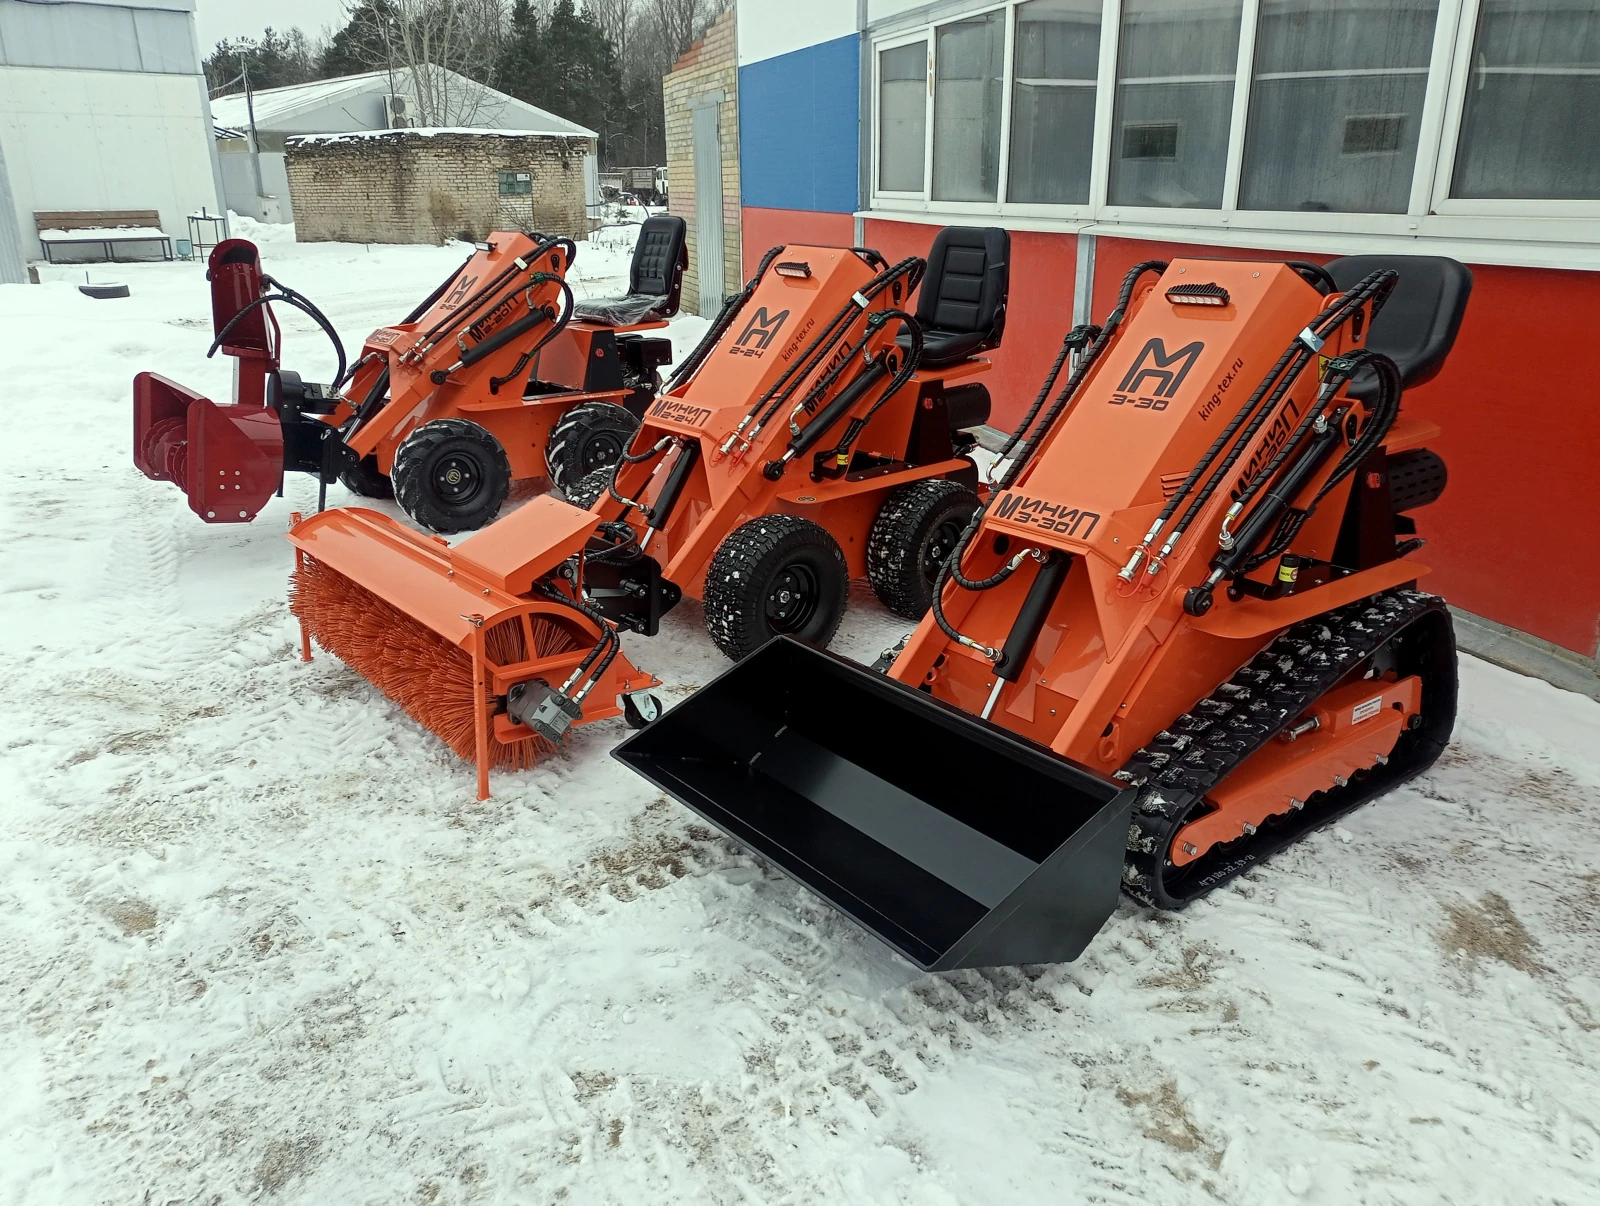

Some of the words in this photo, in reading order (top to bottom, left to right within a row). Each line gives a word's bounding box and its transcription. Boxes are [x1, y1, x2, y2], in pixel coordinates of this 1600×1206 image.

[782, 318, 815, 361] king-tex.ru
[729, 346, 764, 358] 2-24
[1198, 358, 1244, 421] king-tex.ru
[1108, 393, 1169, 411] 3-30
[660, 411, 693, 424] 2-24
[1013, 510, 1070, 533] 3-30
